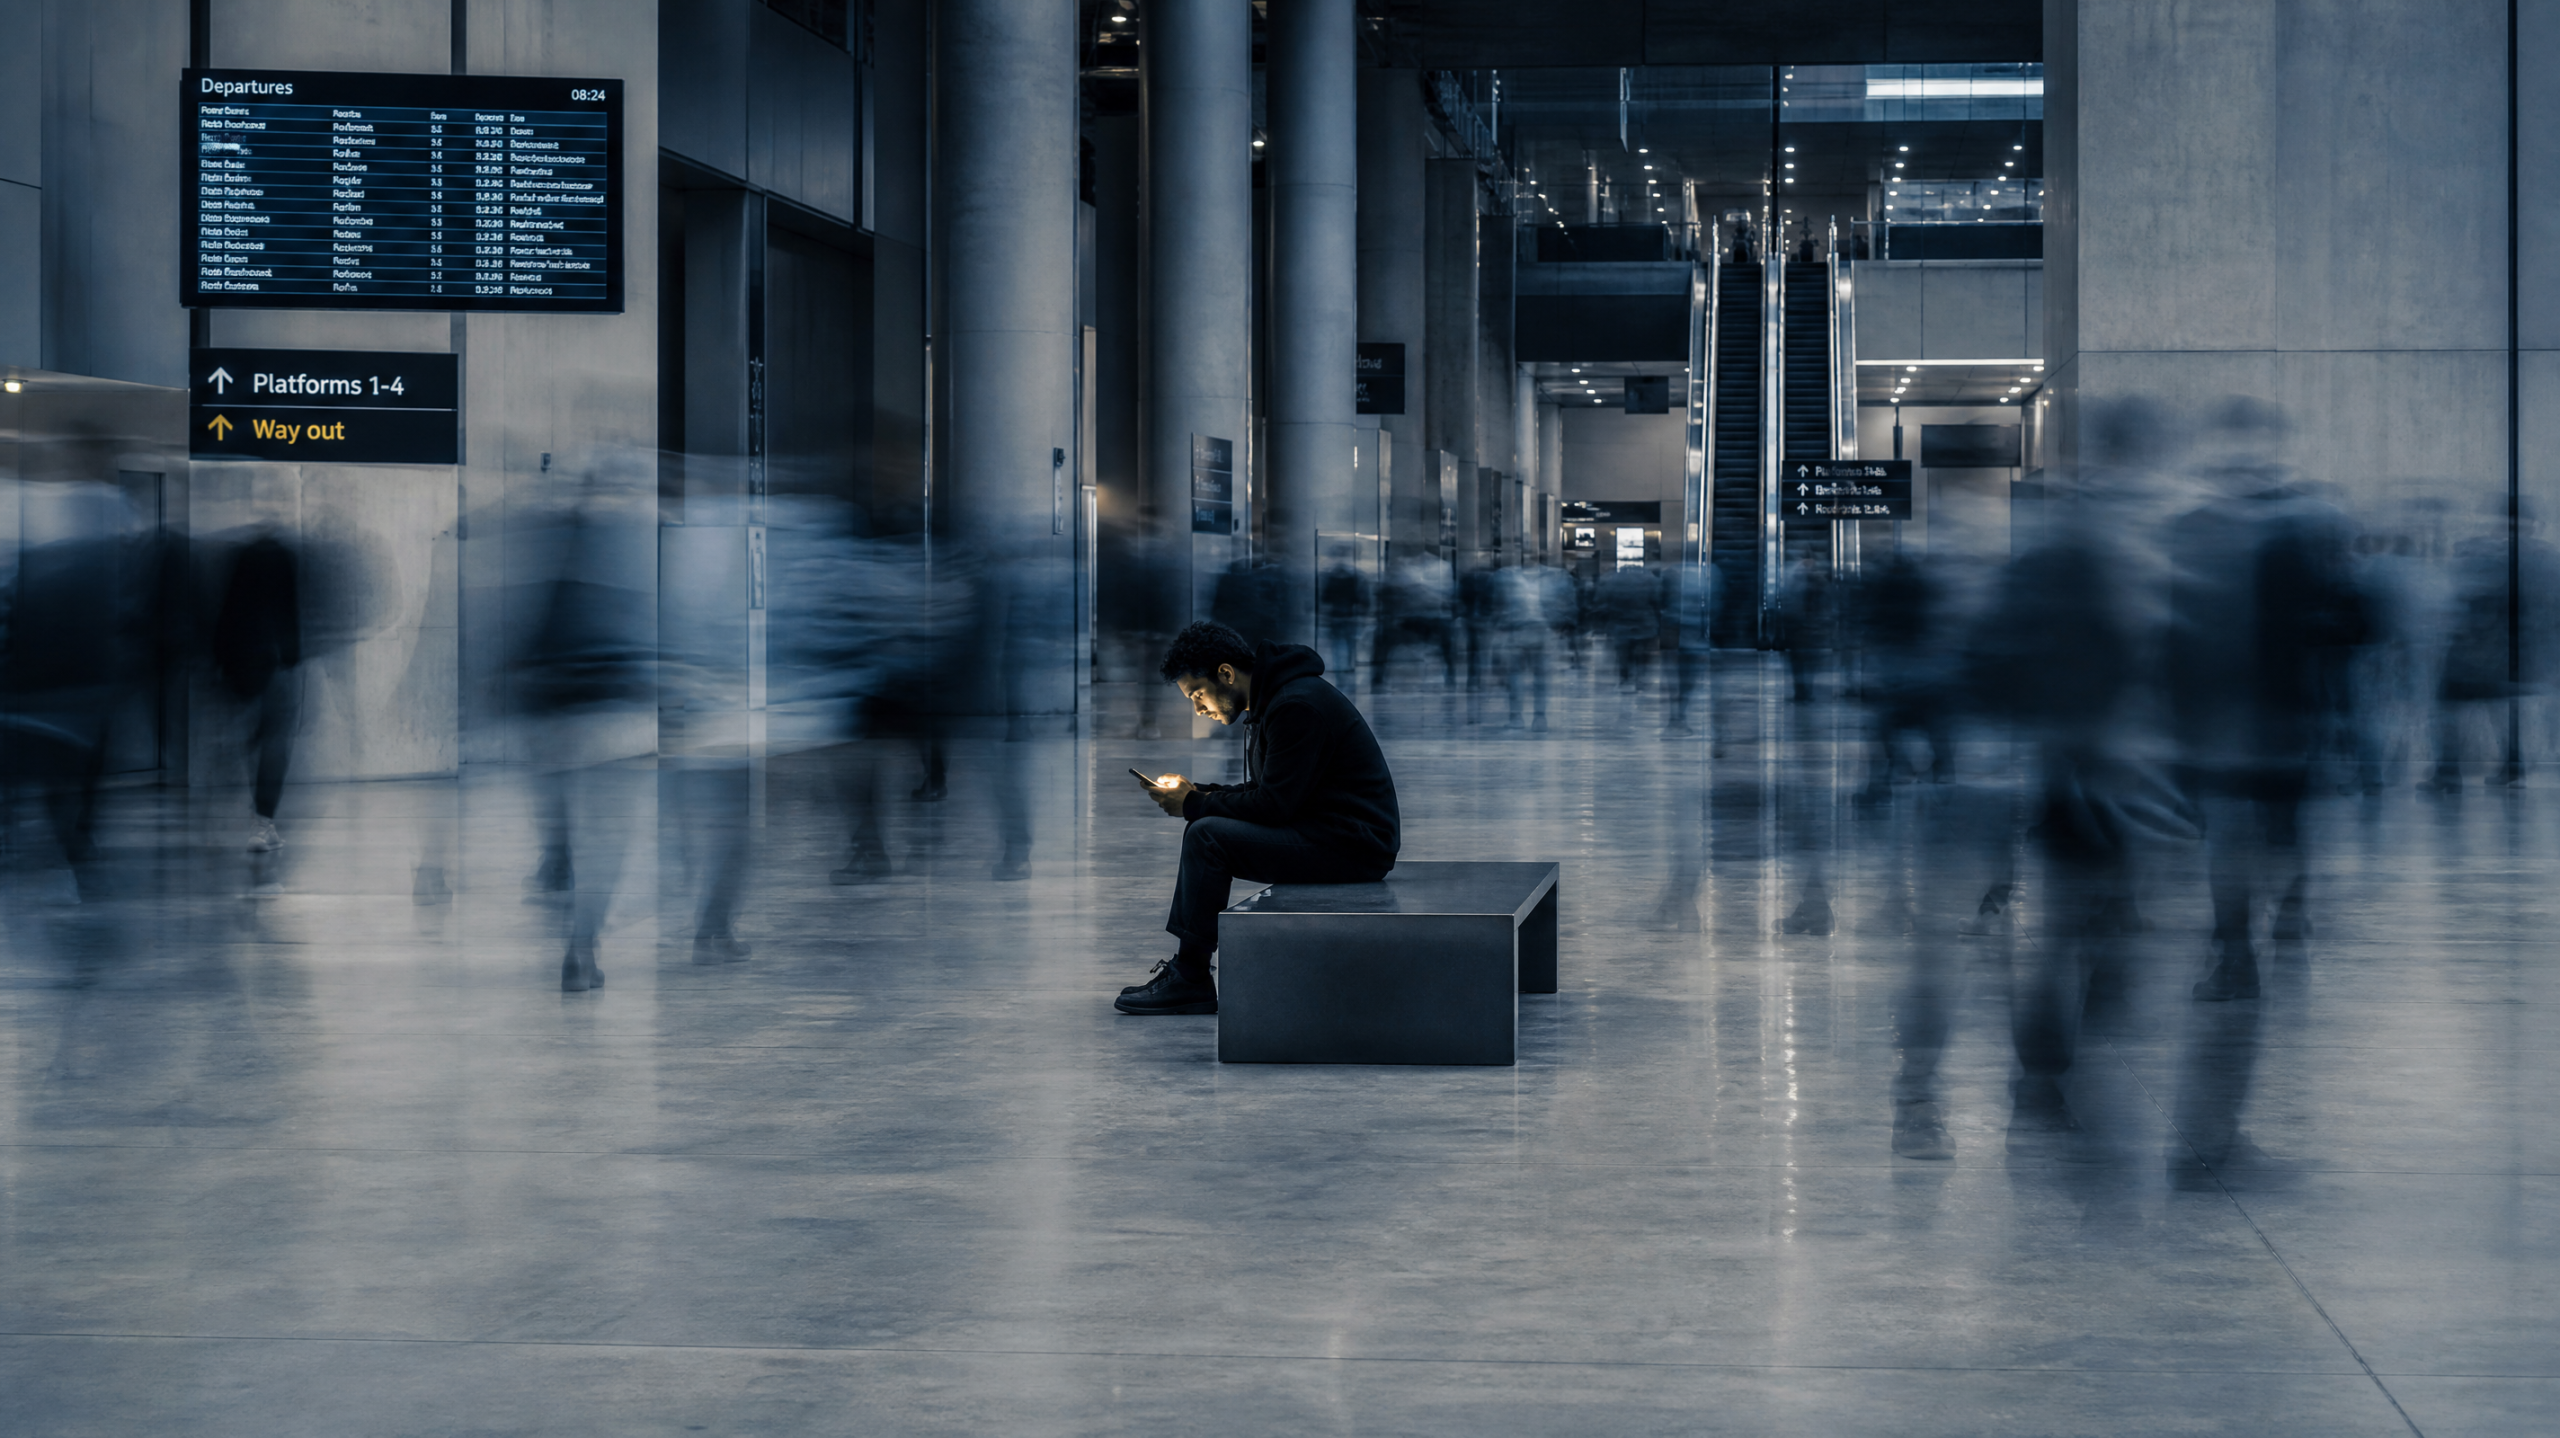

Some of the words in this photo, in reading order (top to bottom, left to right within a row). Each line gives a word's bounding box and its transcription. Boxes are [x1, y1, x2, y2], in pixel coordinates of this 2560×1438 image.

[202, 78, 293, 97] Departures
[572, 89, 605, 101] 08:24
[254, 373, 362, 395] Platforms
[369, 376, 404, 395] 1-4
[253, 420, 300, 444] Way
[307, 422, 344, 440] out
